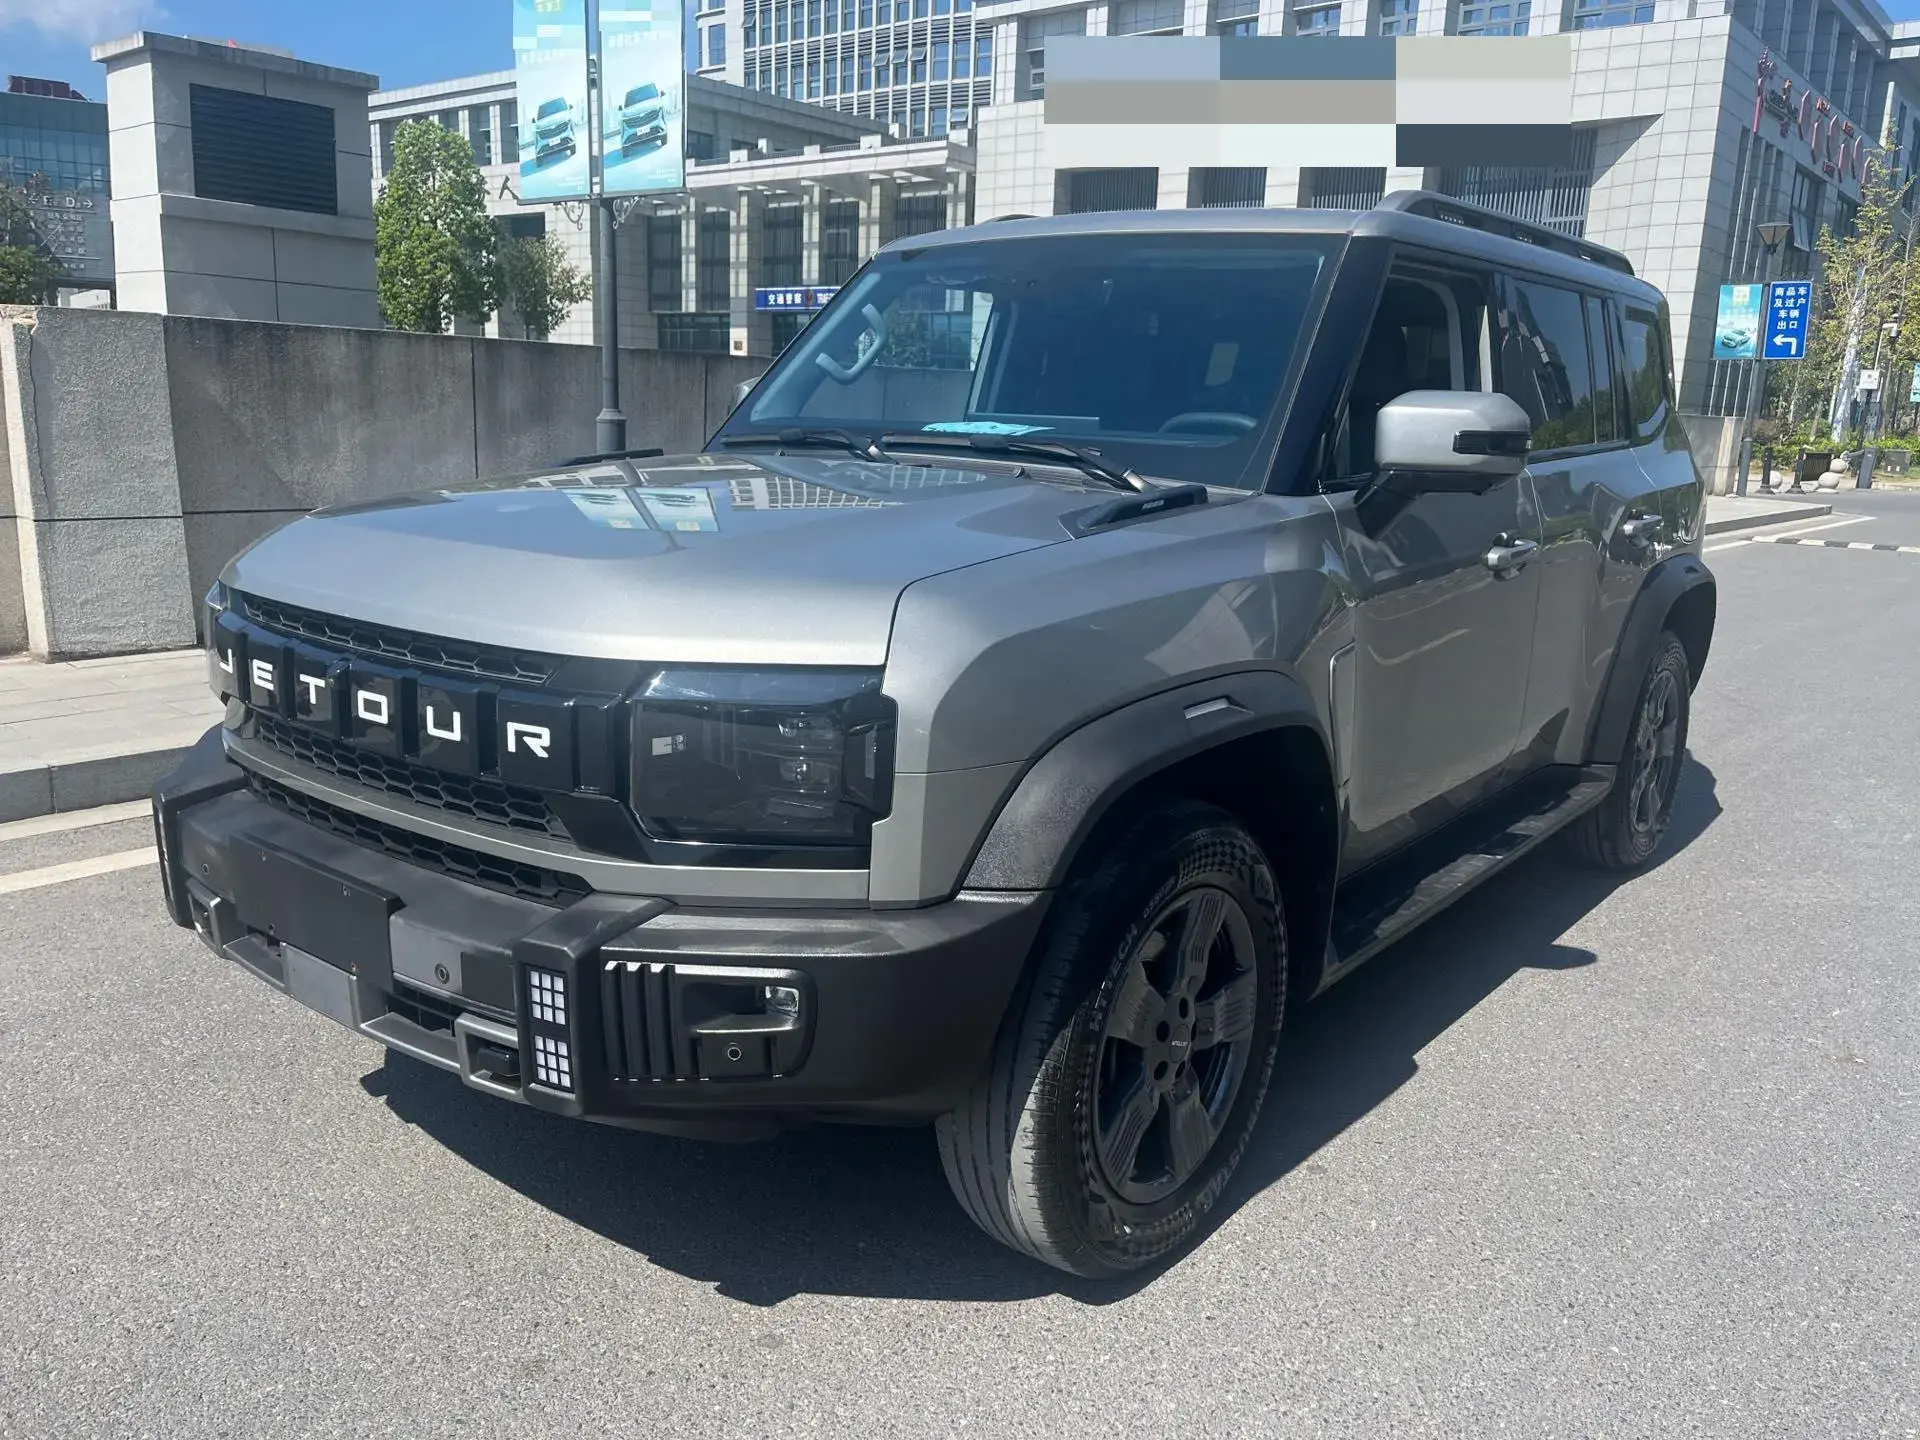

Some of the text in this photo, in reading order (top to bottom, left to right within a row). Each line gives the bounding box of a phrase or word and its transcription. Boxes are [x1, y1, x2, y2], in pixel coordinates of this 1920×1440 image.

[1775, 286, 1807, 296] 商品车
[768, 292, 802, 305] 交通警察
[1773, 297, 1806, 308] 及过户
[1778, 309, 1800, 319] 车辆
[1777, 320, 1798, 330] 出口
[218, 647, 552, 759] JETOUR
